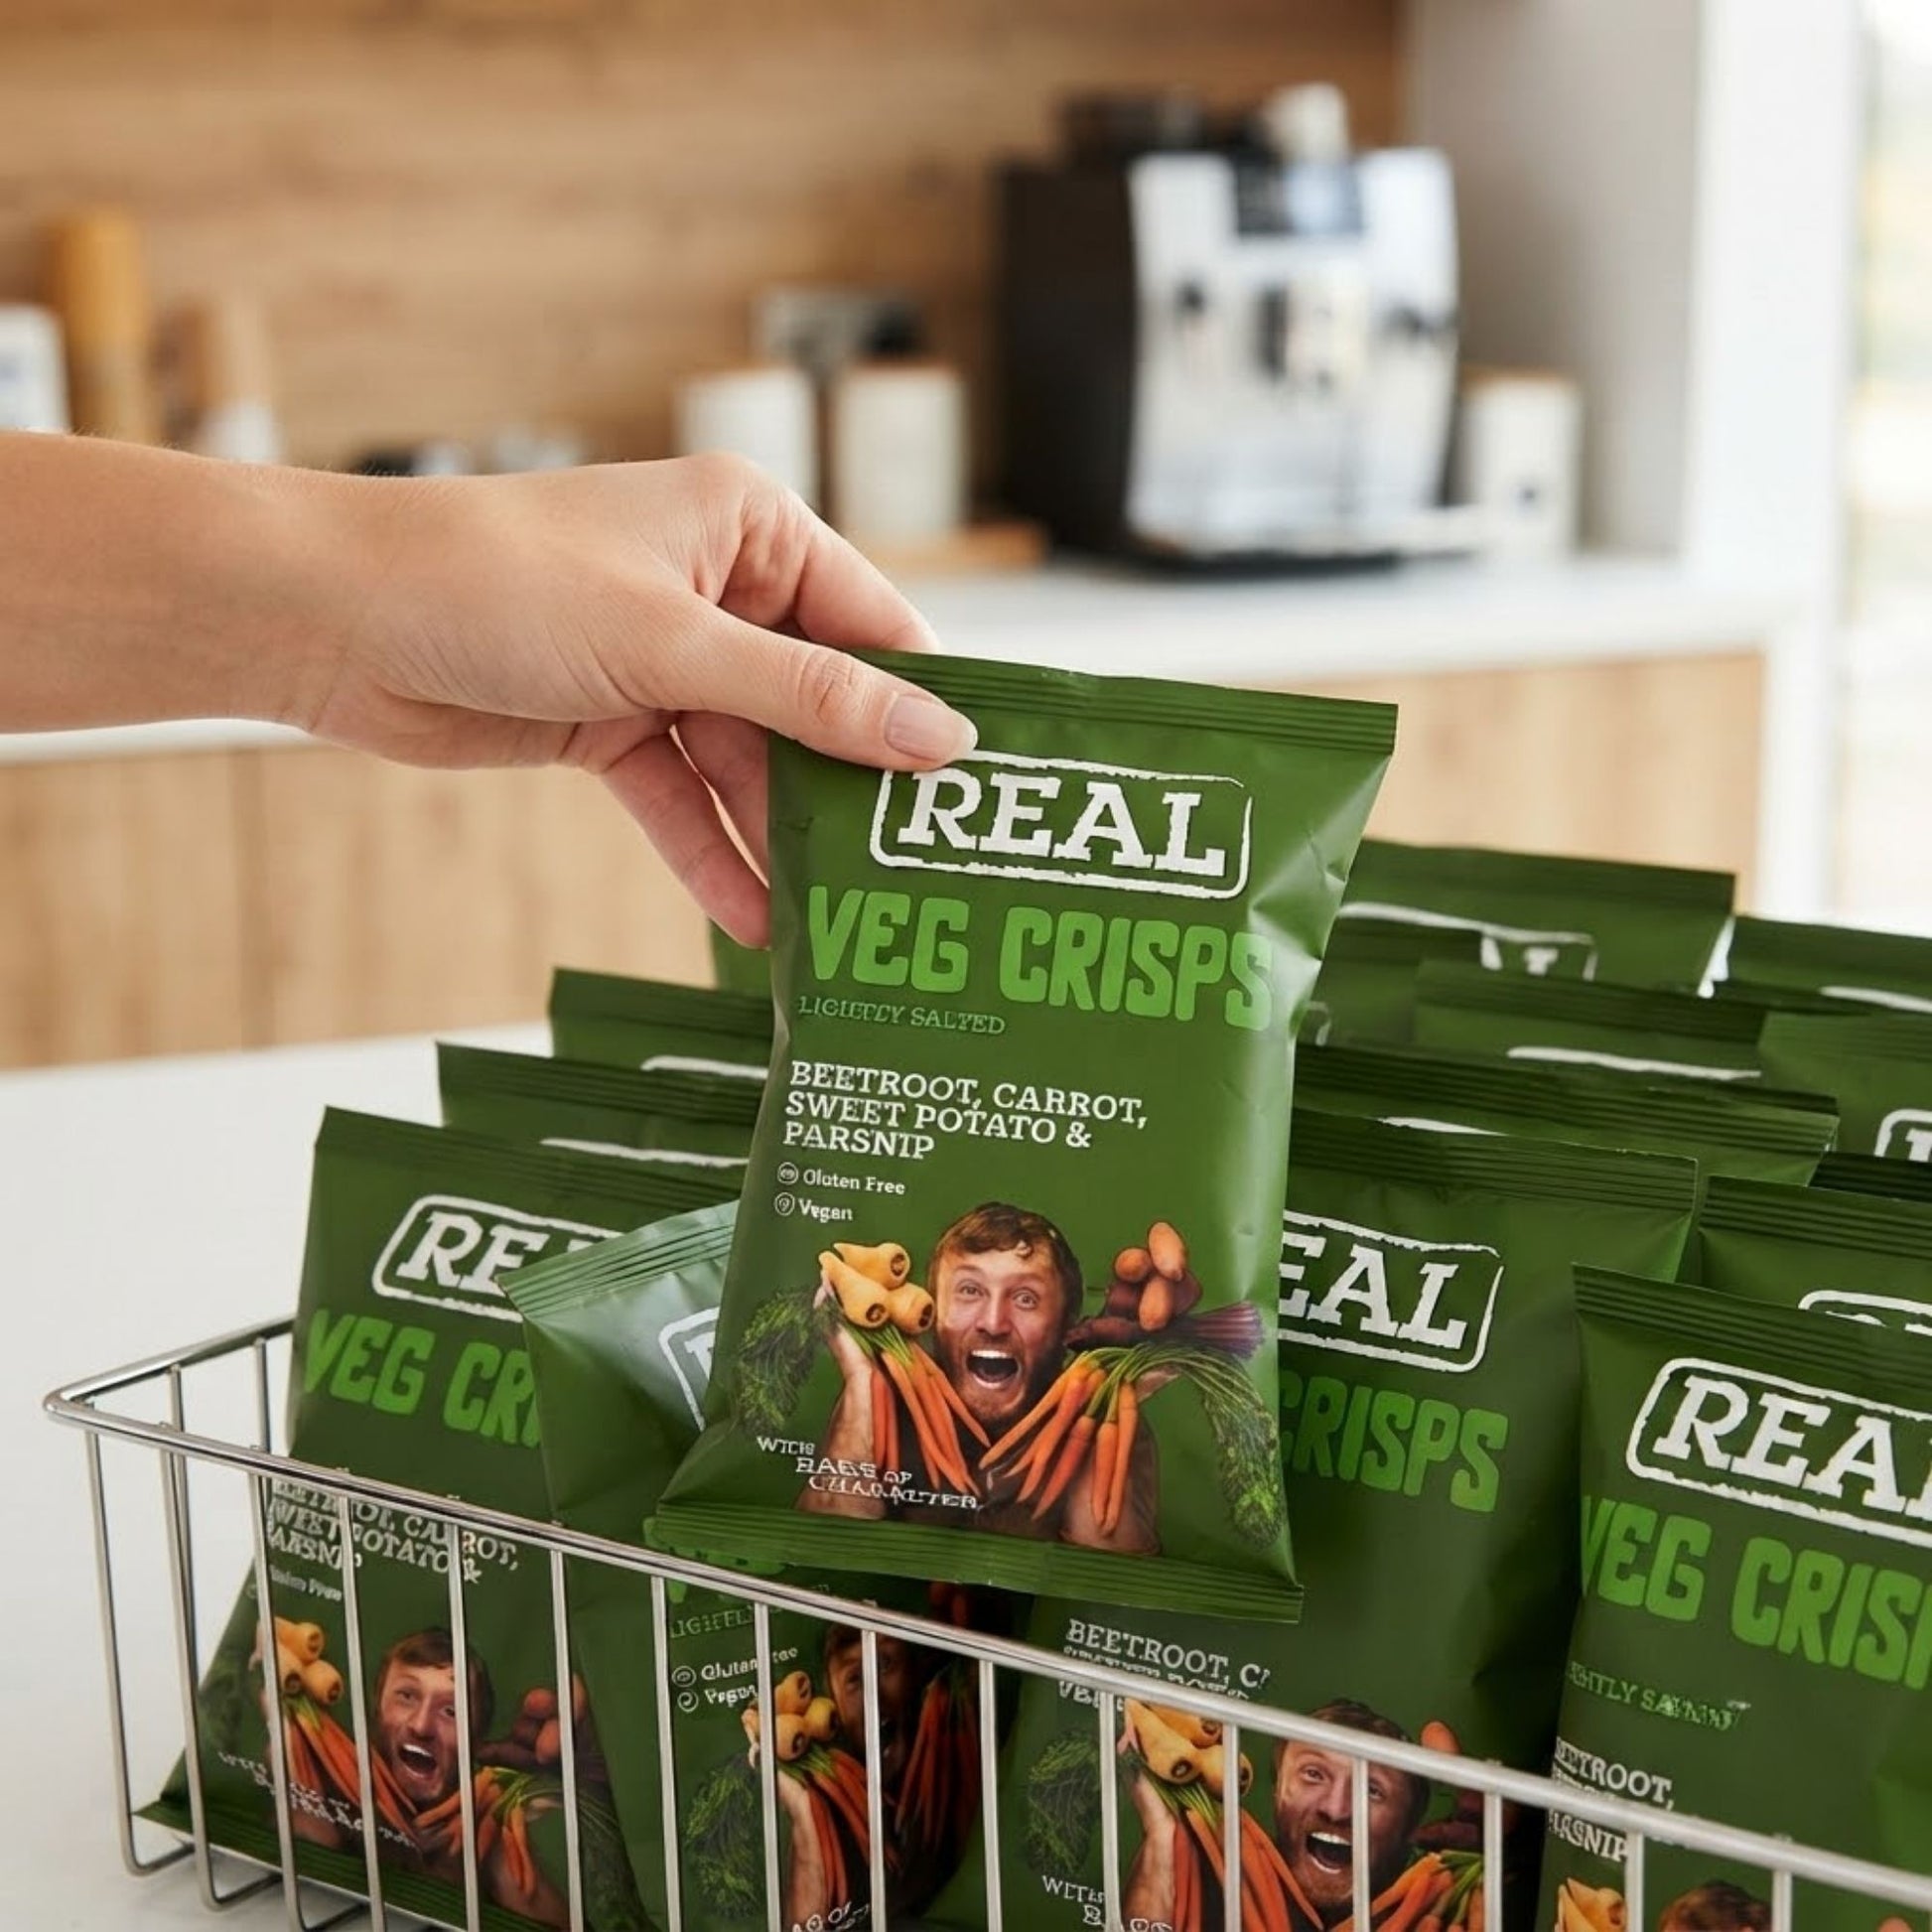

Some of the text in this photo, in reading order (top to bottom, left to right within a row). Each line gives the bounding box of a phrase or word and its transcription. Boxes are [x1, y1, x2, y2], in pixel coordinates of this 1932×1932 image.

[897, 768, 1226, 877] REAL
[808, 886, 1275, 1032] VEG CRISPS
[785, 1091, 1092, 1148] SWEET POTATO &
[790, 1060, 1148, 1129] BEETROOT, CARROT,
[783, 1121, 935, 1160] PARSNIP
[799, 1198, 853, 1224] Vegan
[865, 1176, 905, 1195] Free
[395, 1210, 596, 1298] RE
[1279, 1231, 1466, 1350] EAL
[304, 1309, 436, 1416] VEG
[403, 1515, 518, 1571] CAROT,
[1731, 1537, 1932, 1690] CRIS
[1065, 1618, 1230, 1685] BEETROOT,
